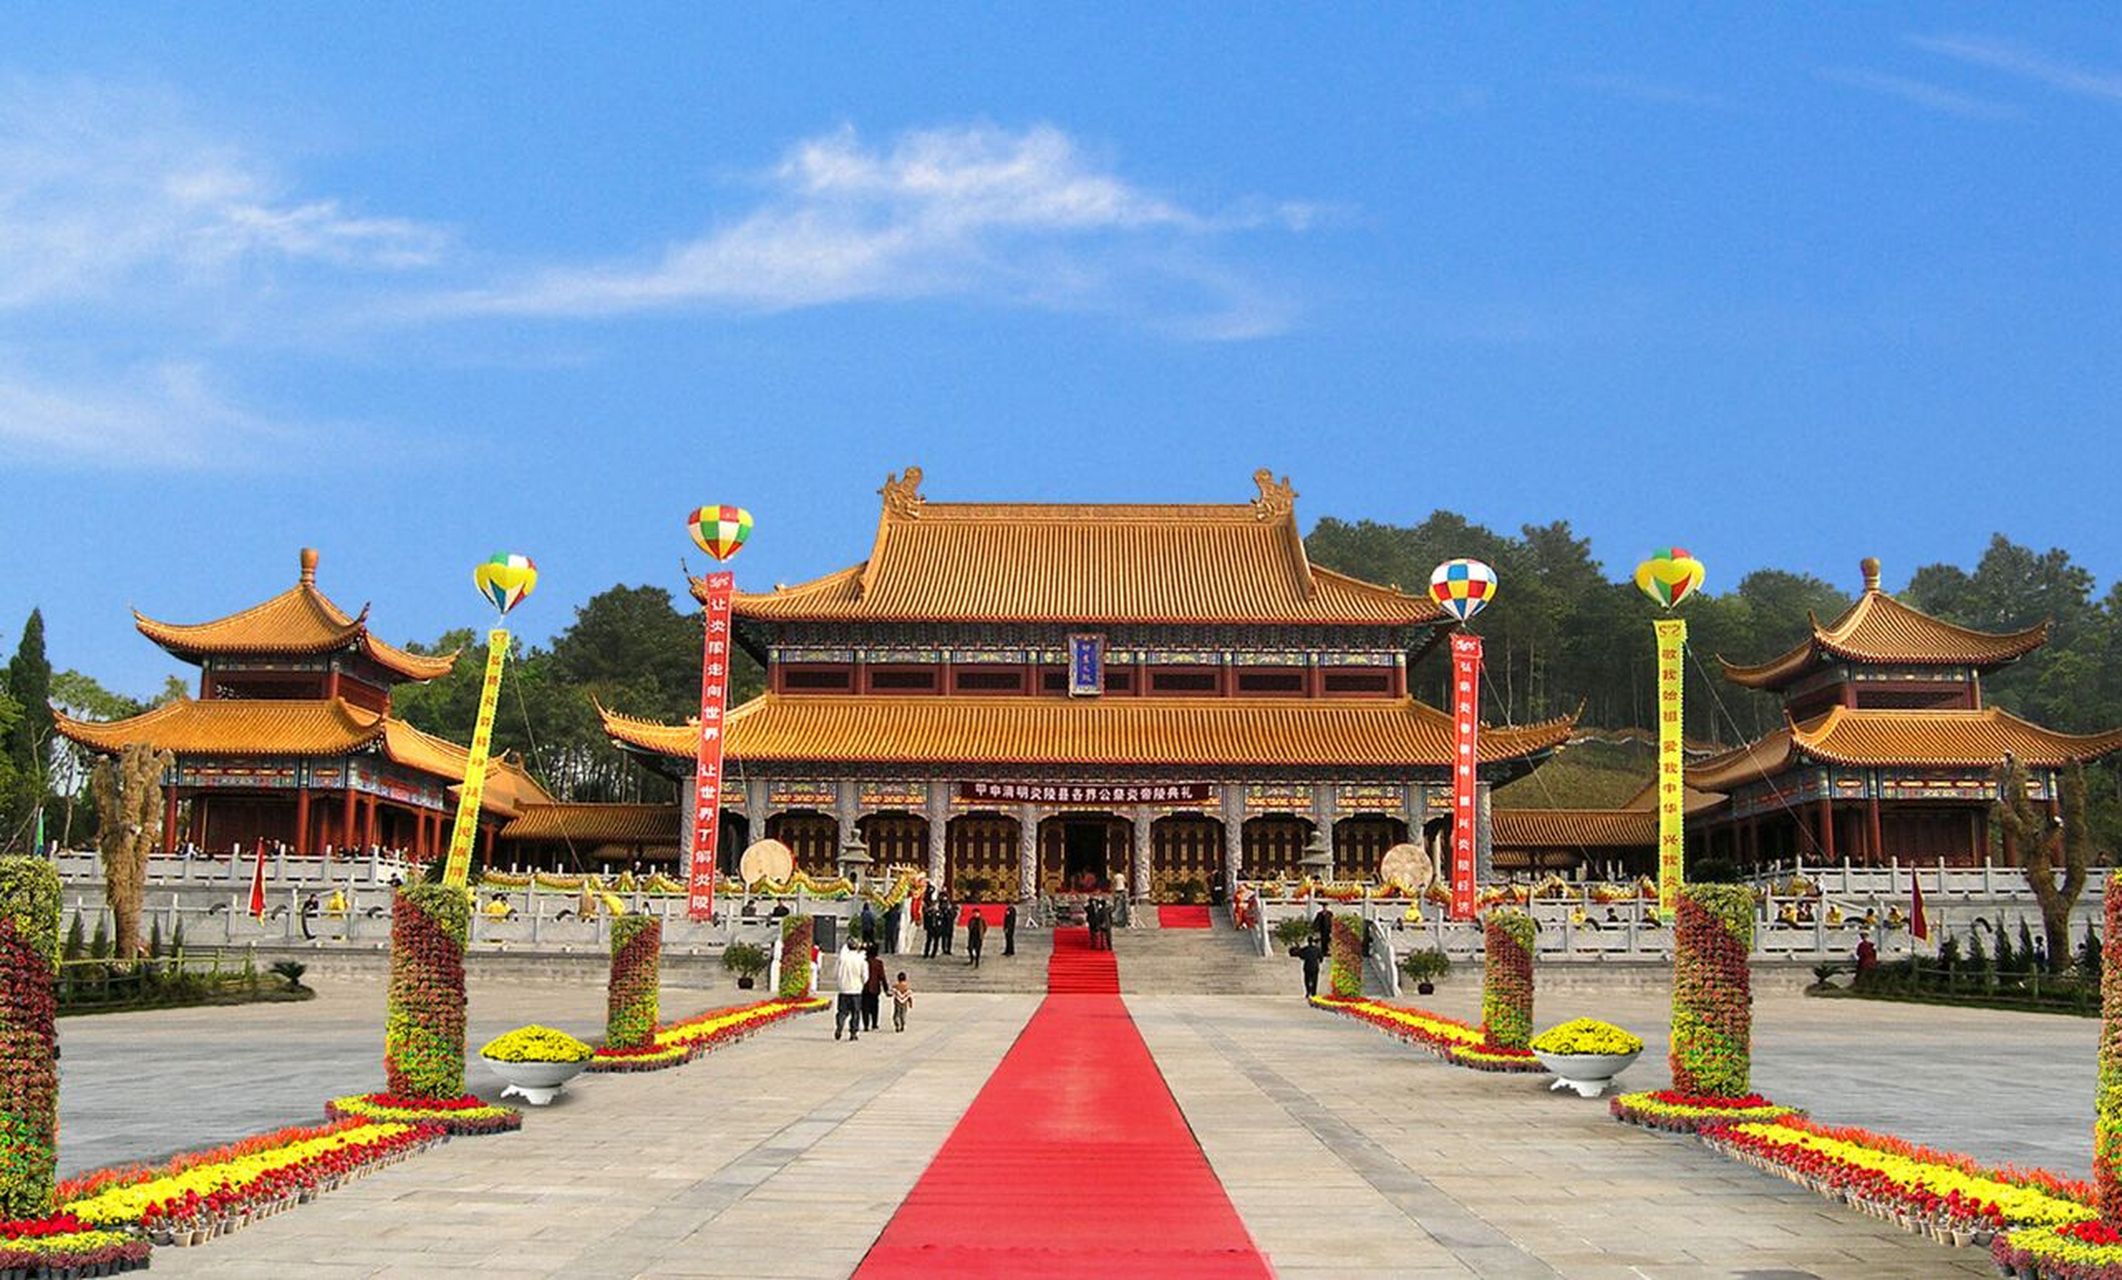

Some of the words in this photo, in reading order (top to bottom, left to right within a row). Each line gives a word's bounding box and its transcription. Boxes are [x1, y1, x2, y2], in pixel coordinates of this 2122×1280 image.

[703, 597, 728, 741] 让炎陵走向世界
[692, 763, 716, 909] 让世界了解炎陵
